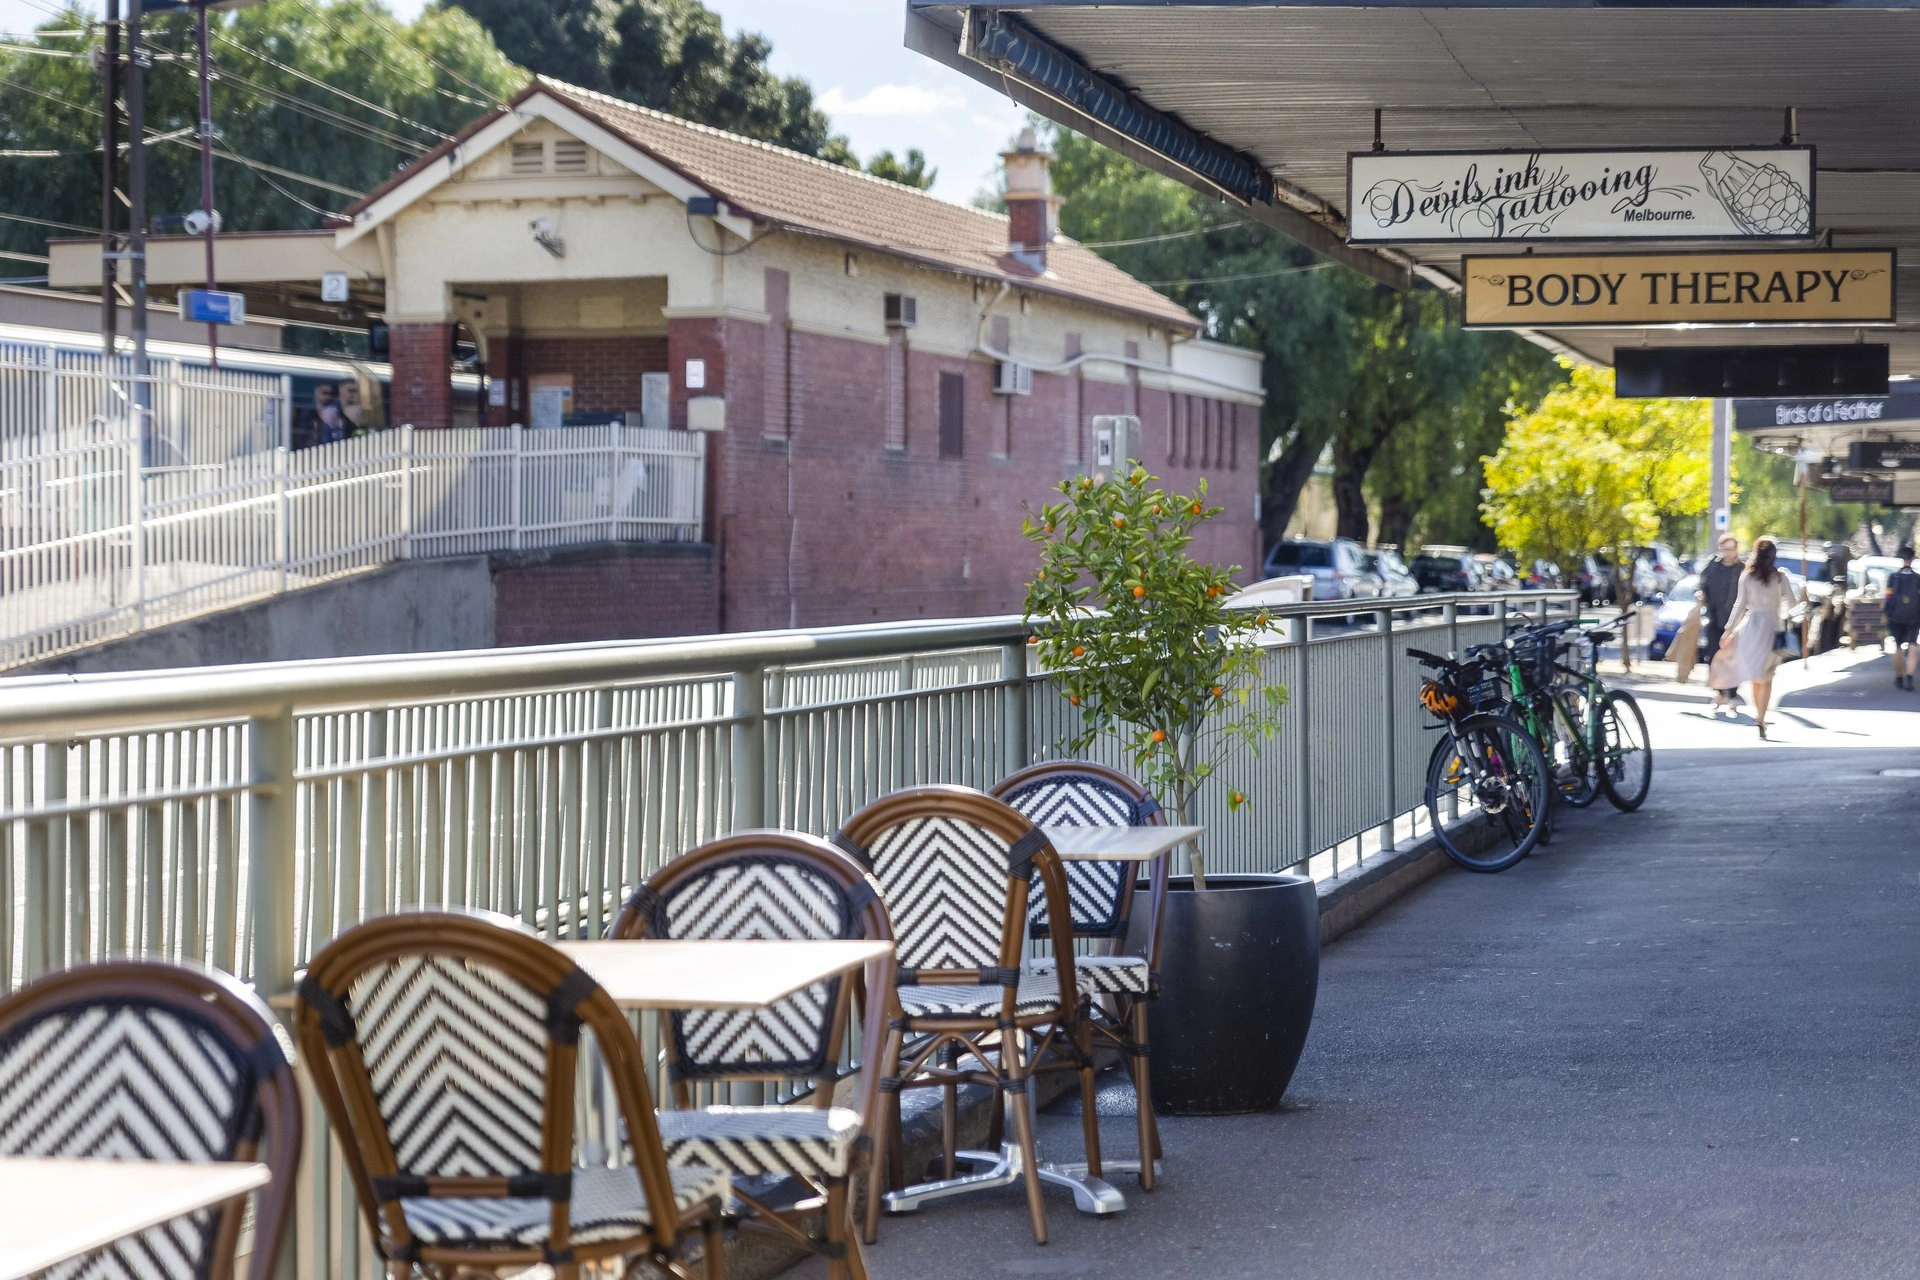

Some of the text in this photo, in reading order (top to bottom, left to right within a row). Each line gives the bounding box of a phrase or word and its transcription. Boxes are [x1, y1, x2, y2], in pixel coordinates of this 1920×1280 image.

[1362, 153, 1543, 228] Devils ink
[1478, 165, 1656, 238] Tattooing
[1623, 208, 1696, 222] Melbourne.
[327, 278, 340, 297] 2
[1506, 270, 1850, 307] BODY THERAPY
[1775, 404, 1808, 425] Birds
[1808, 402, 1823, 423] of
[1833, 400, 1884, 421] Feather
